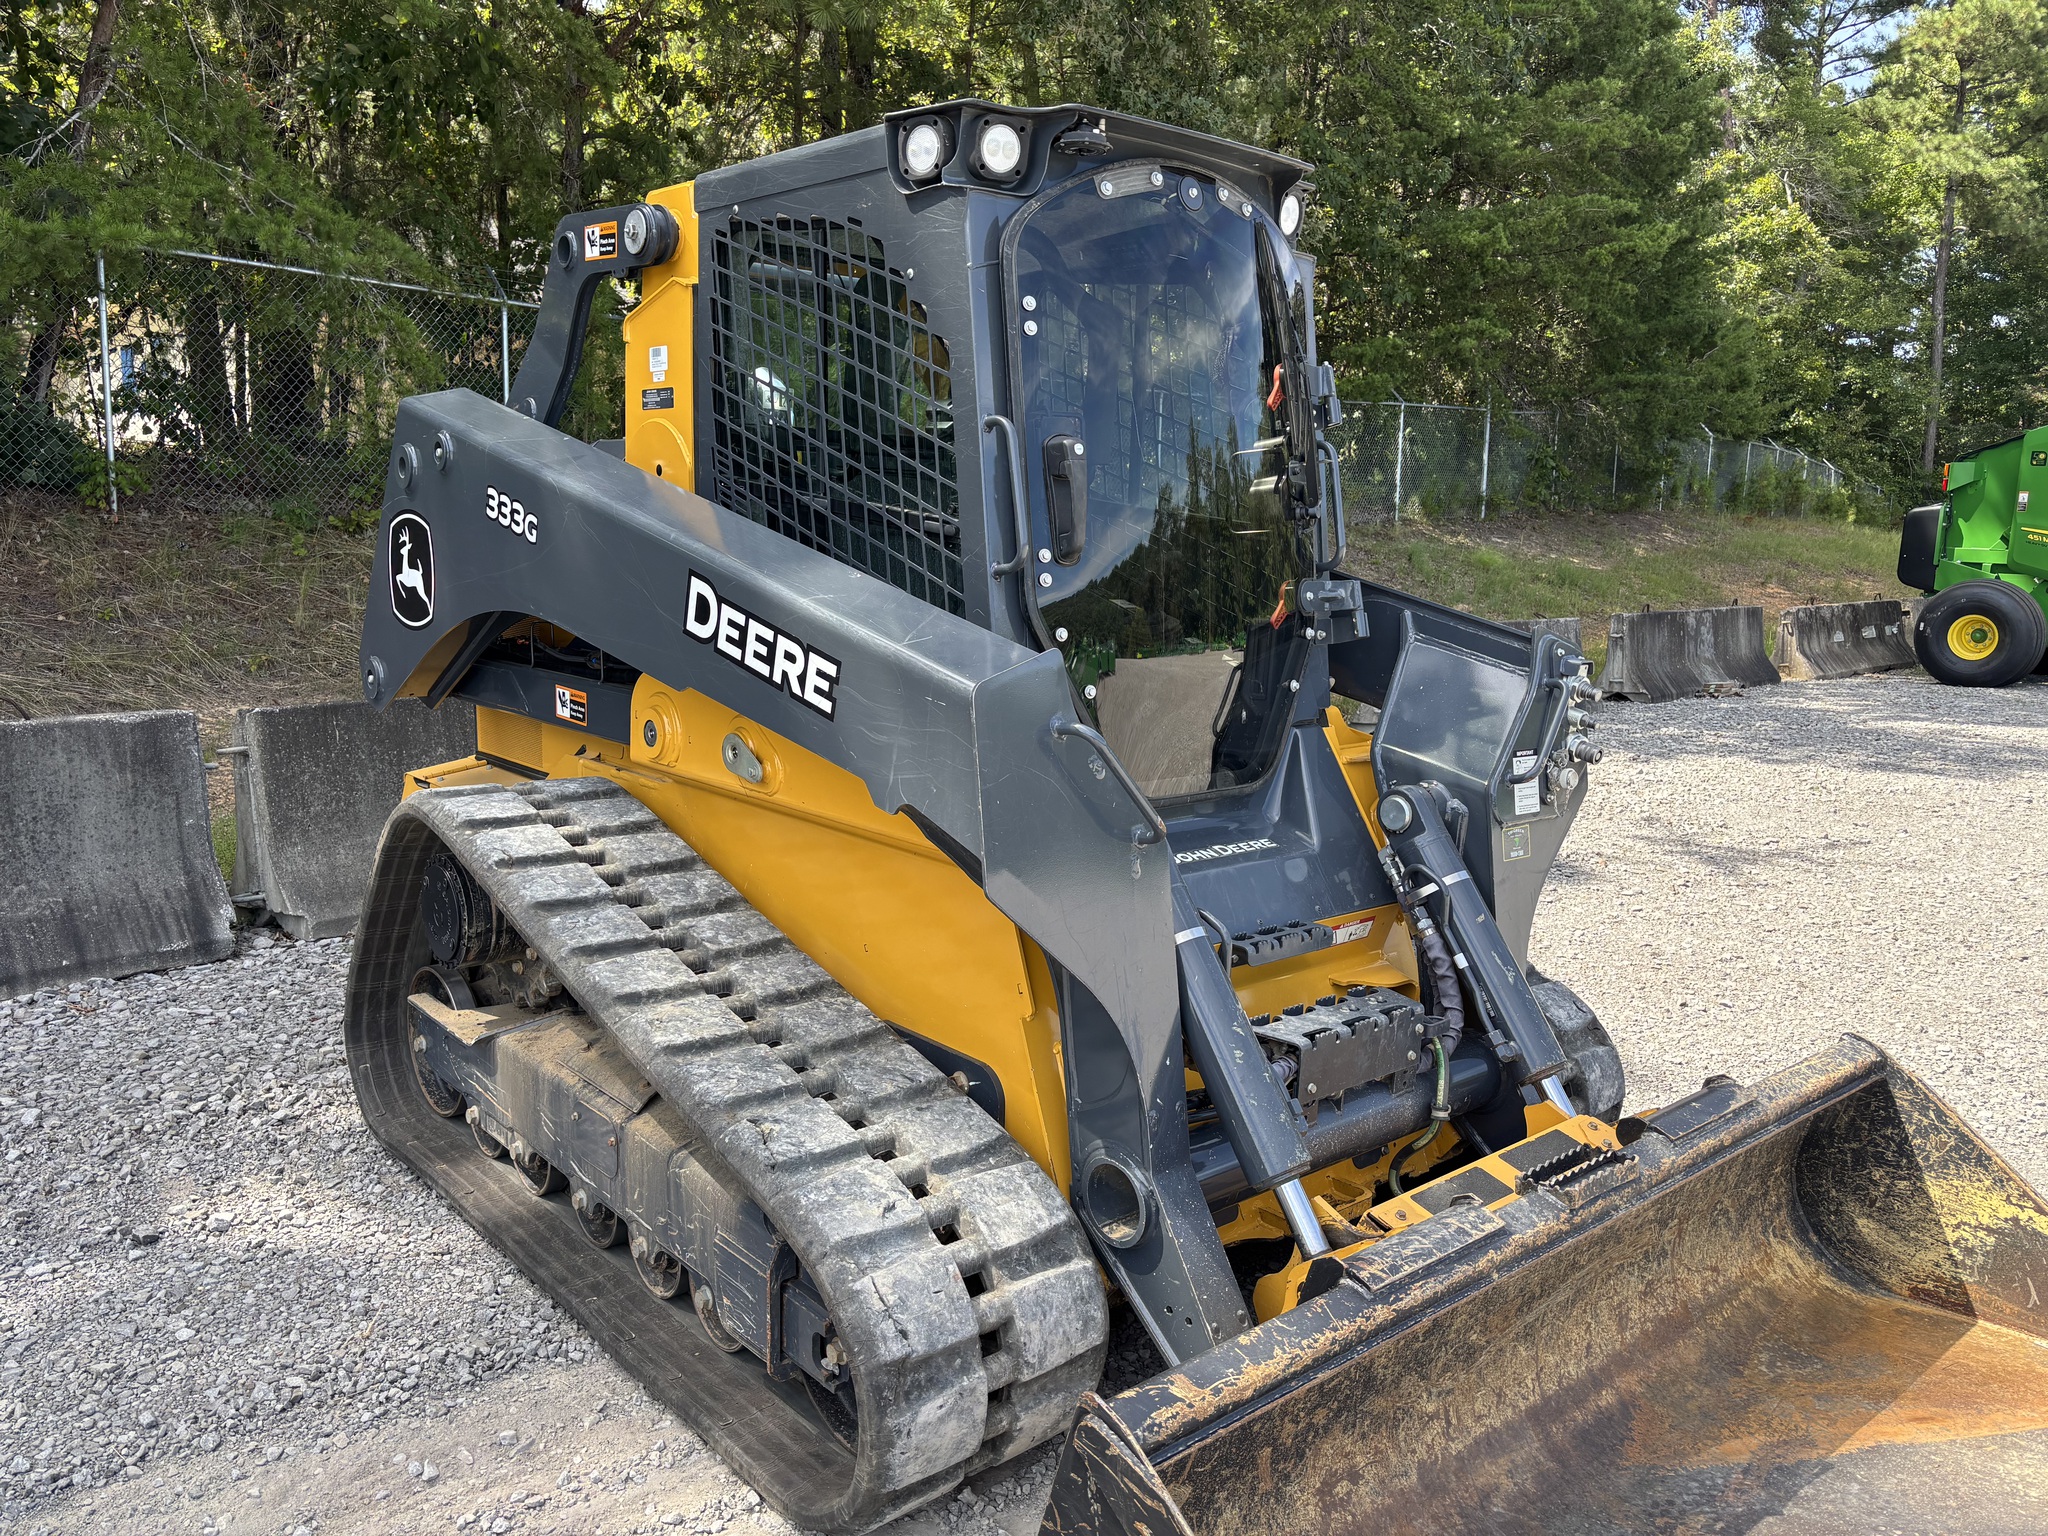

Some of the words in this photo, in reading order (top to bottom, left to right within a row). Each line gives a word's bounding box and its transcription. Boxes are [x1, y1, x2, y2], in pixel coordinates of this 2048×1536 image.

[486, 487, 538, 544] 333G
[685, 574, 838, 715] DEERE
[1212, 838, 1277, 857] DEERE
